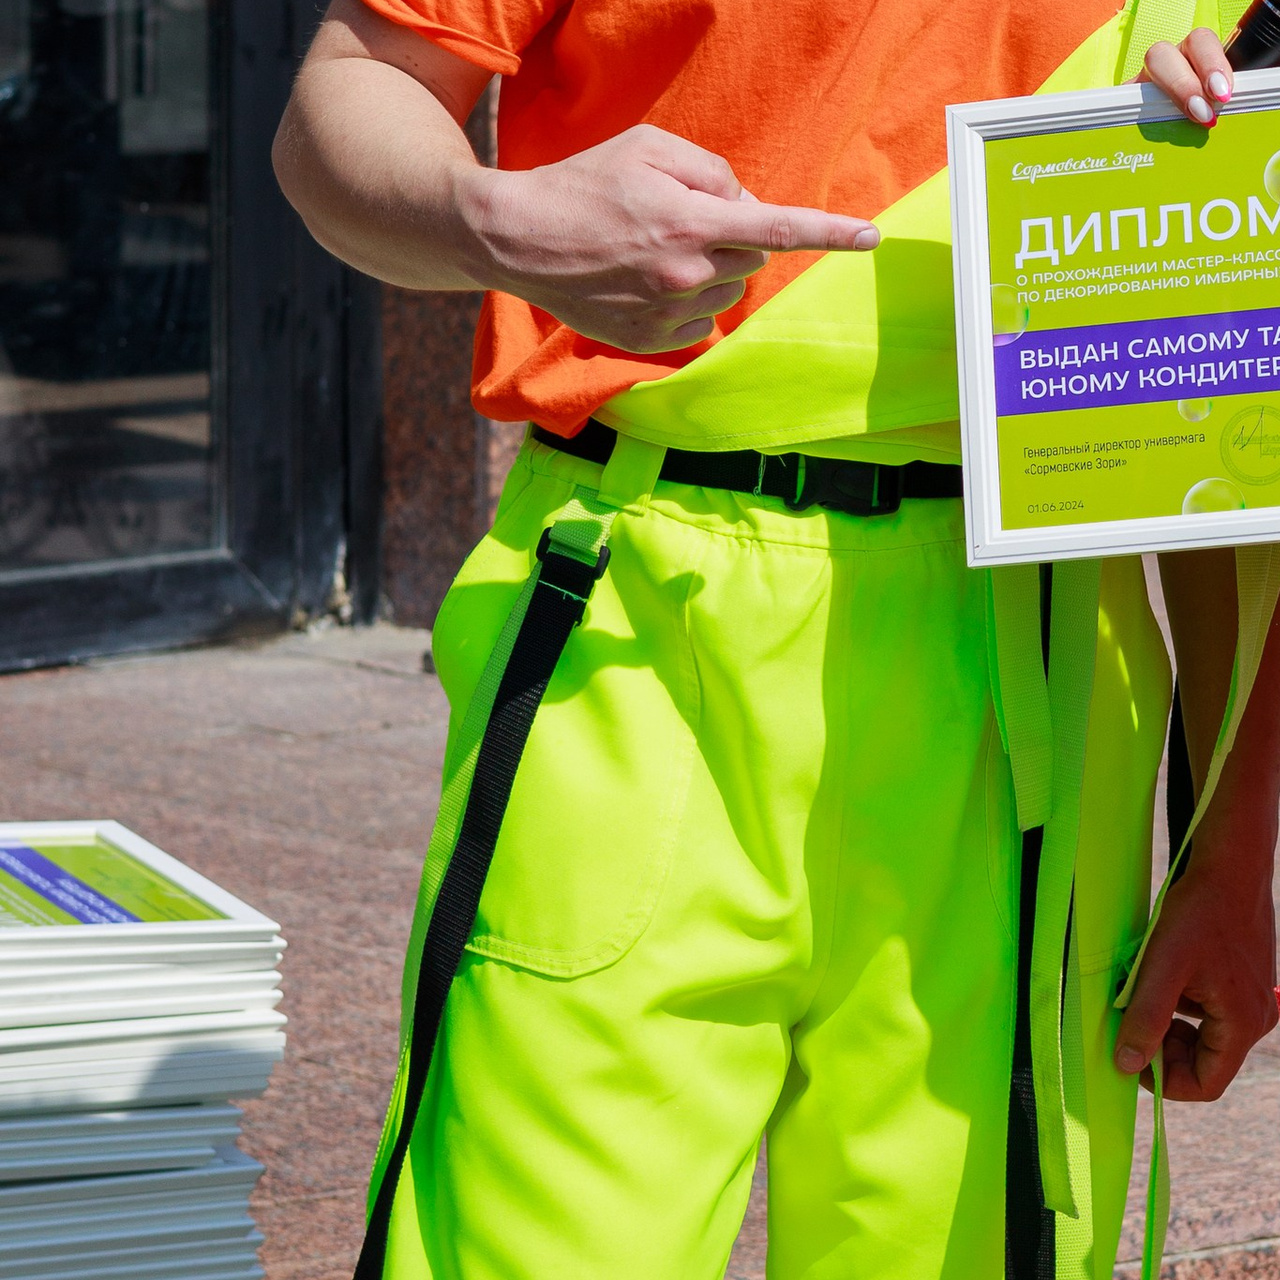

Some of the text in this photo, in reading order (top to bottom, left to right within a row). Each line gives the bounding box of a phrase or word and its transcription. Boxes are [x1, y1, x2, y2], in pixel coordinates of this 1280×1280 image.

[1012, 151, 1154, 184] Сормовские Зори
[1016, 274, 1028, 286] О
[1032, 261, 1157, 285] ПРОХОЖДЕНИИ
[1017, 290, 1040, 303] ПО
[1044, 276, 1190, 303] ДЕКОРИРОВАНИЮ
[1020, 341, 1119, 370] ВЫДАН
[1127, 328, 1250, 359] САМОМУ
[1021, 370, 1130, 400] ЮНОМУ
[1023, 432, 1206, 459] Генеральный директор универмага
[1024, 457, 1128, 476] «Сормовские Зори»
[1027, 500, 1085, 514] 01.06.2024
